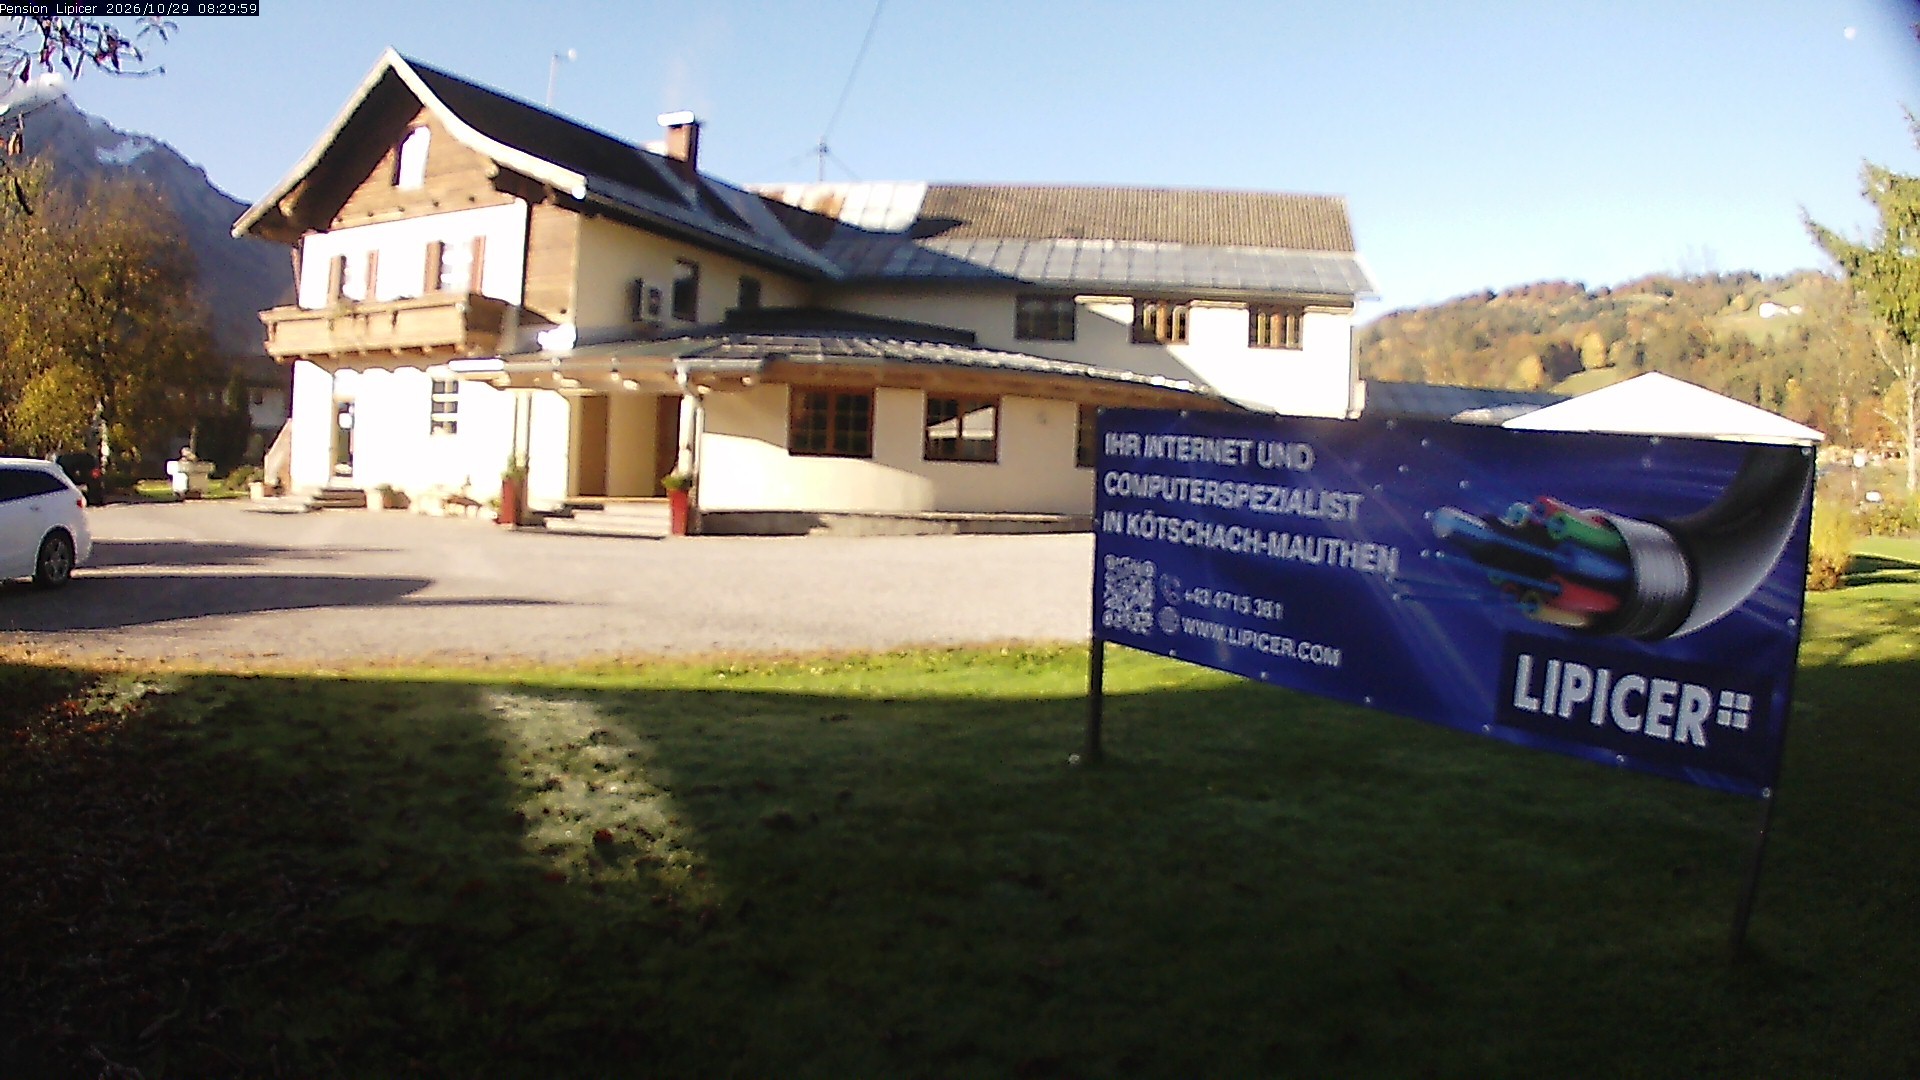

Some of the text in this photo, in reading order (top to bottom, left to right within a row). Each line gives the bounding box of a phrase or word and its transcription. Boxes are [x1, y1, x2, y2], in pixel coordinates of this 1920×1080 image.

[1104, 432, 1315, 472] IHR INTERNET UND
[1103, 471, 1364, 522] COMPUTERSPEZIALIST
[1102, 510, 1400, 574] IN KÖTSCHACH-MAUTHEN
[1181, 616, 1343, 667] WWW.LIPICER.COM
[1513, 654, 1714, 747] LIPICER
